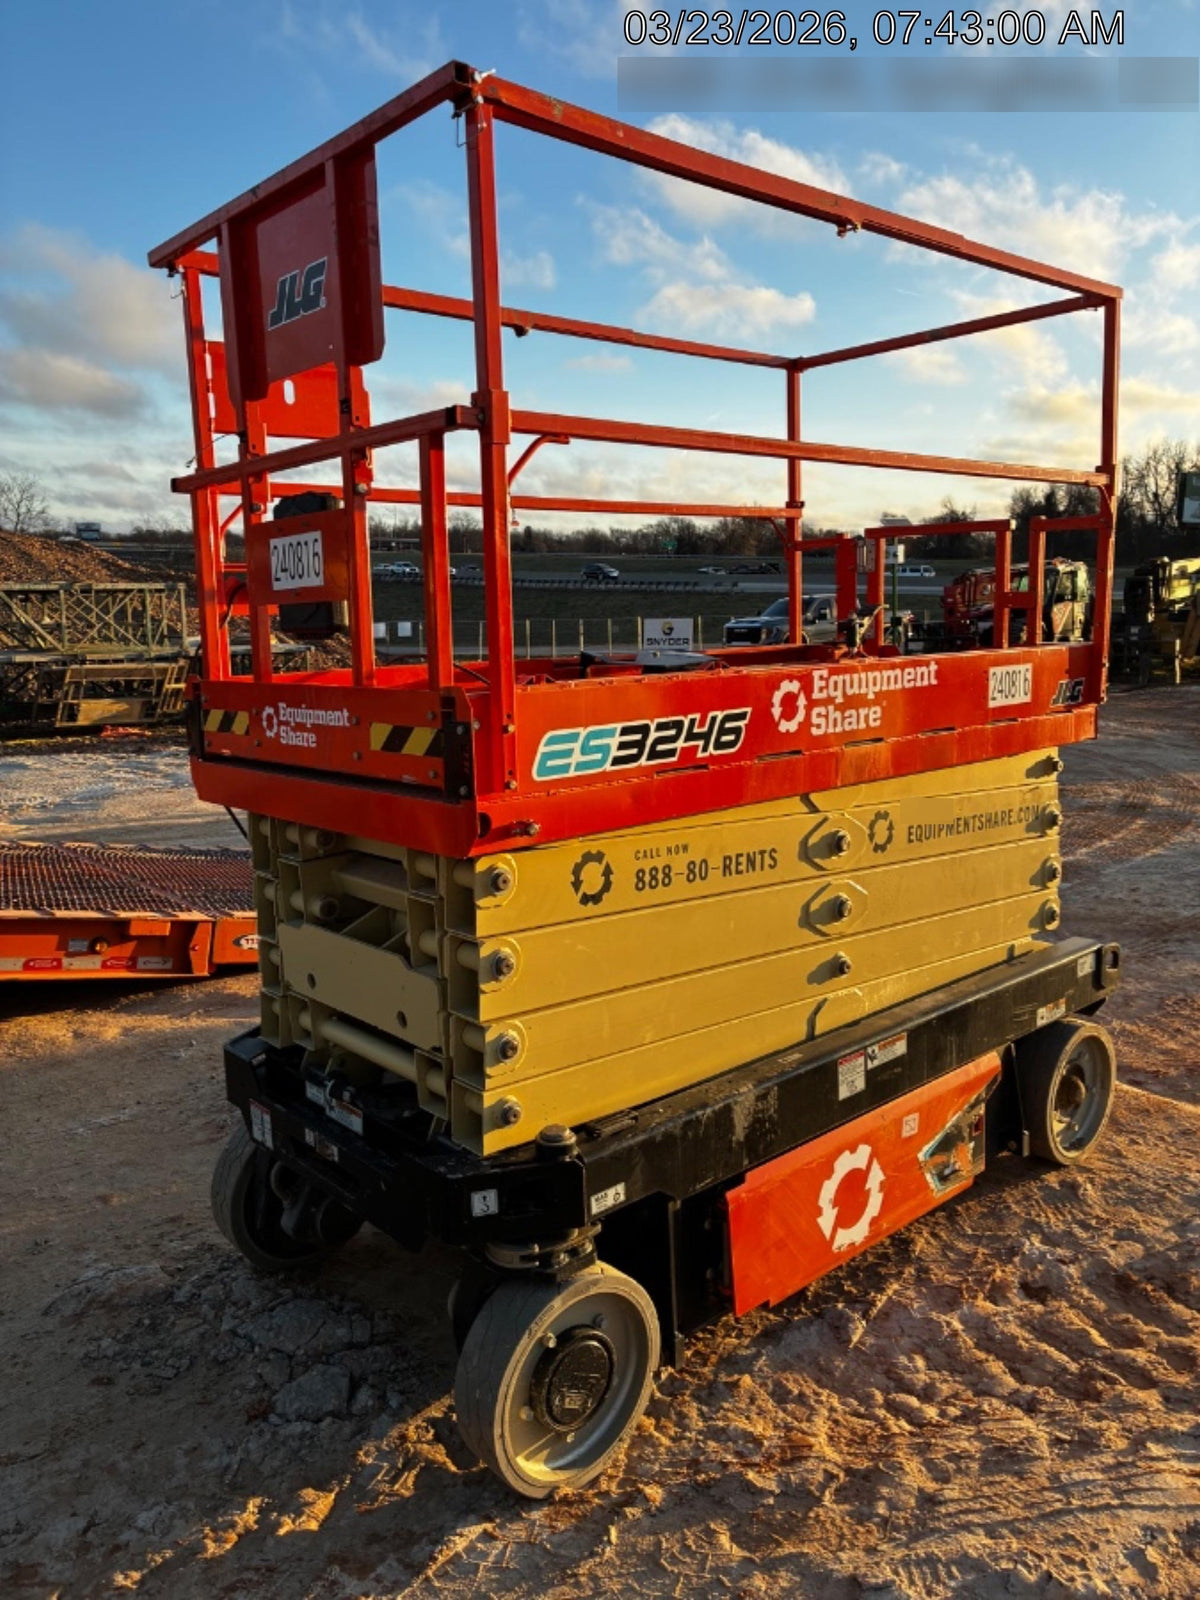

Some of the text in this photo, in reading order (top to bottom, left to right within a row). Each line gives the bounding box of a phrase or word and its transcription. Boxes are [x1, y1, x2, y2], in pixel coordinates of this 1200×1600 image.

[267, 256, 328, 331] JLG
[271, 538, 320, 582] 240816
[646, 637, 690, 646] SNYDER
[811, 660, 938, 703] Equipment
[990, 668, 1030, 701] 240816
[278, 702, 350, 728] Equipment
[810, 705, 884, 736] Share
[280, 725, 317, 748] Share
[533, 708, 752, 781] ES3246
[634, 843, 690, 861] CALL NOW
[634, 848, 778, 892] 888-80-RENTS
